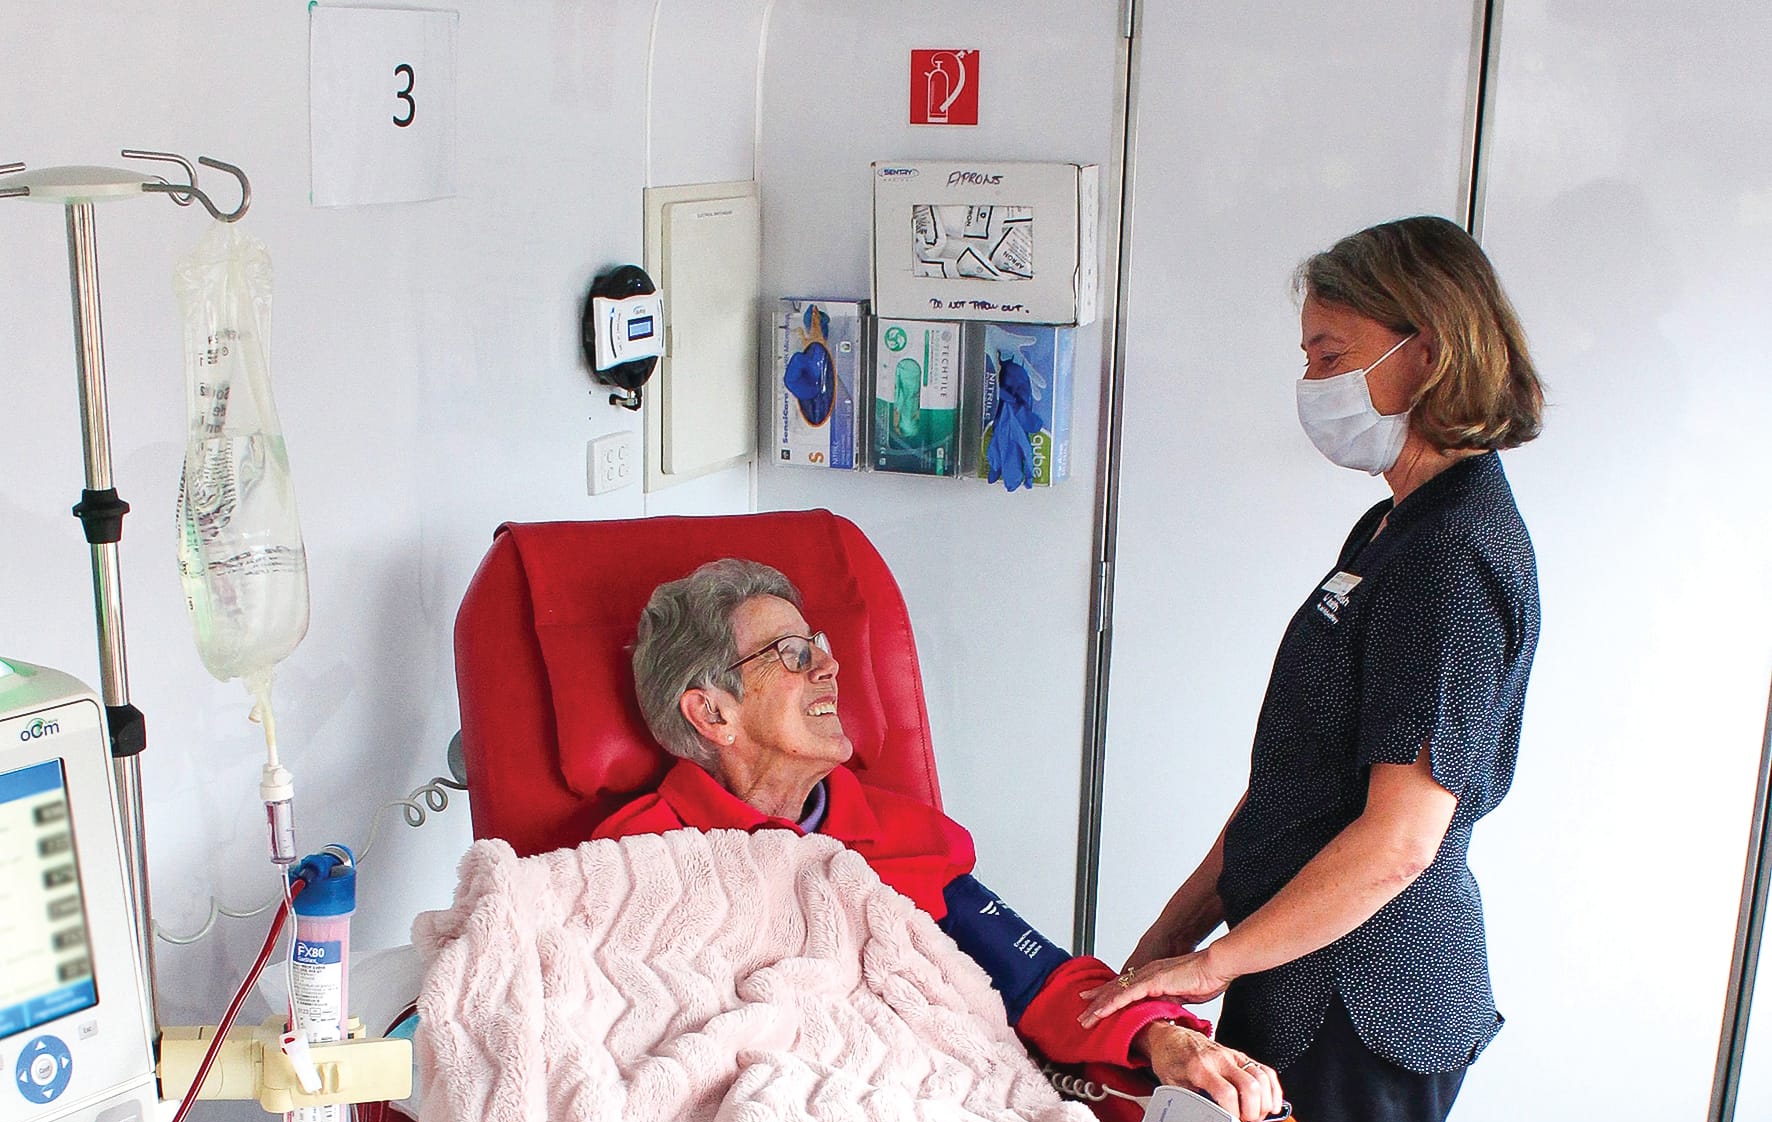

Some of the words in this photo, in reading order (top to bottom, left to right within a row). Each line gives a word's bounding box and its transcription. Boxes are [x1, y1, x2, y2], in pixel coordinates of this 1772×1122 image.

[392, 63, 416, 128] 3
[946, 170, 1004, 187] APRONS
[929, 298, 943, 309] DO
[948, 300, 967, 309] NOT
[940, 345, 949, 398] TECHTILE
[808, 451, 825, 464] S
[297, 944, 325, 958] FX80
